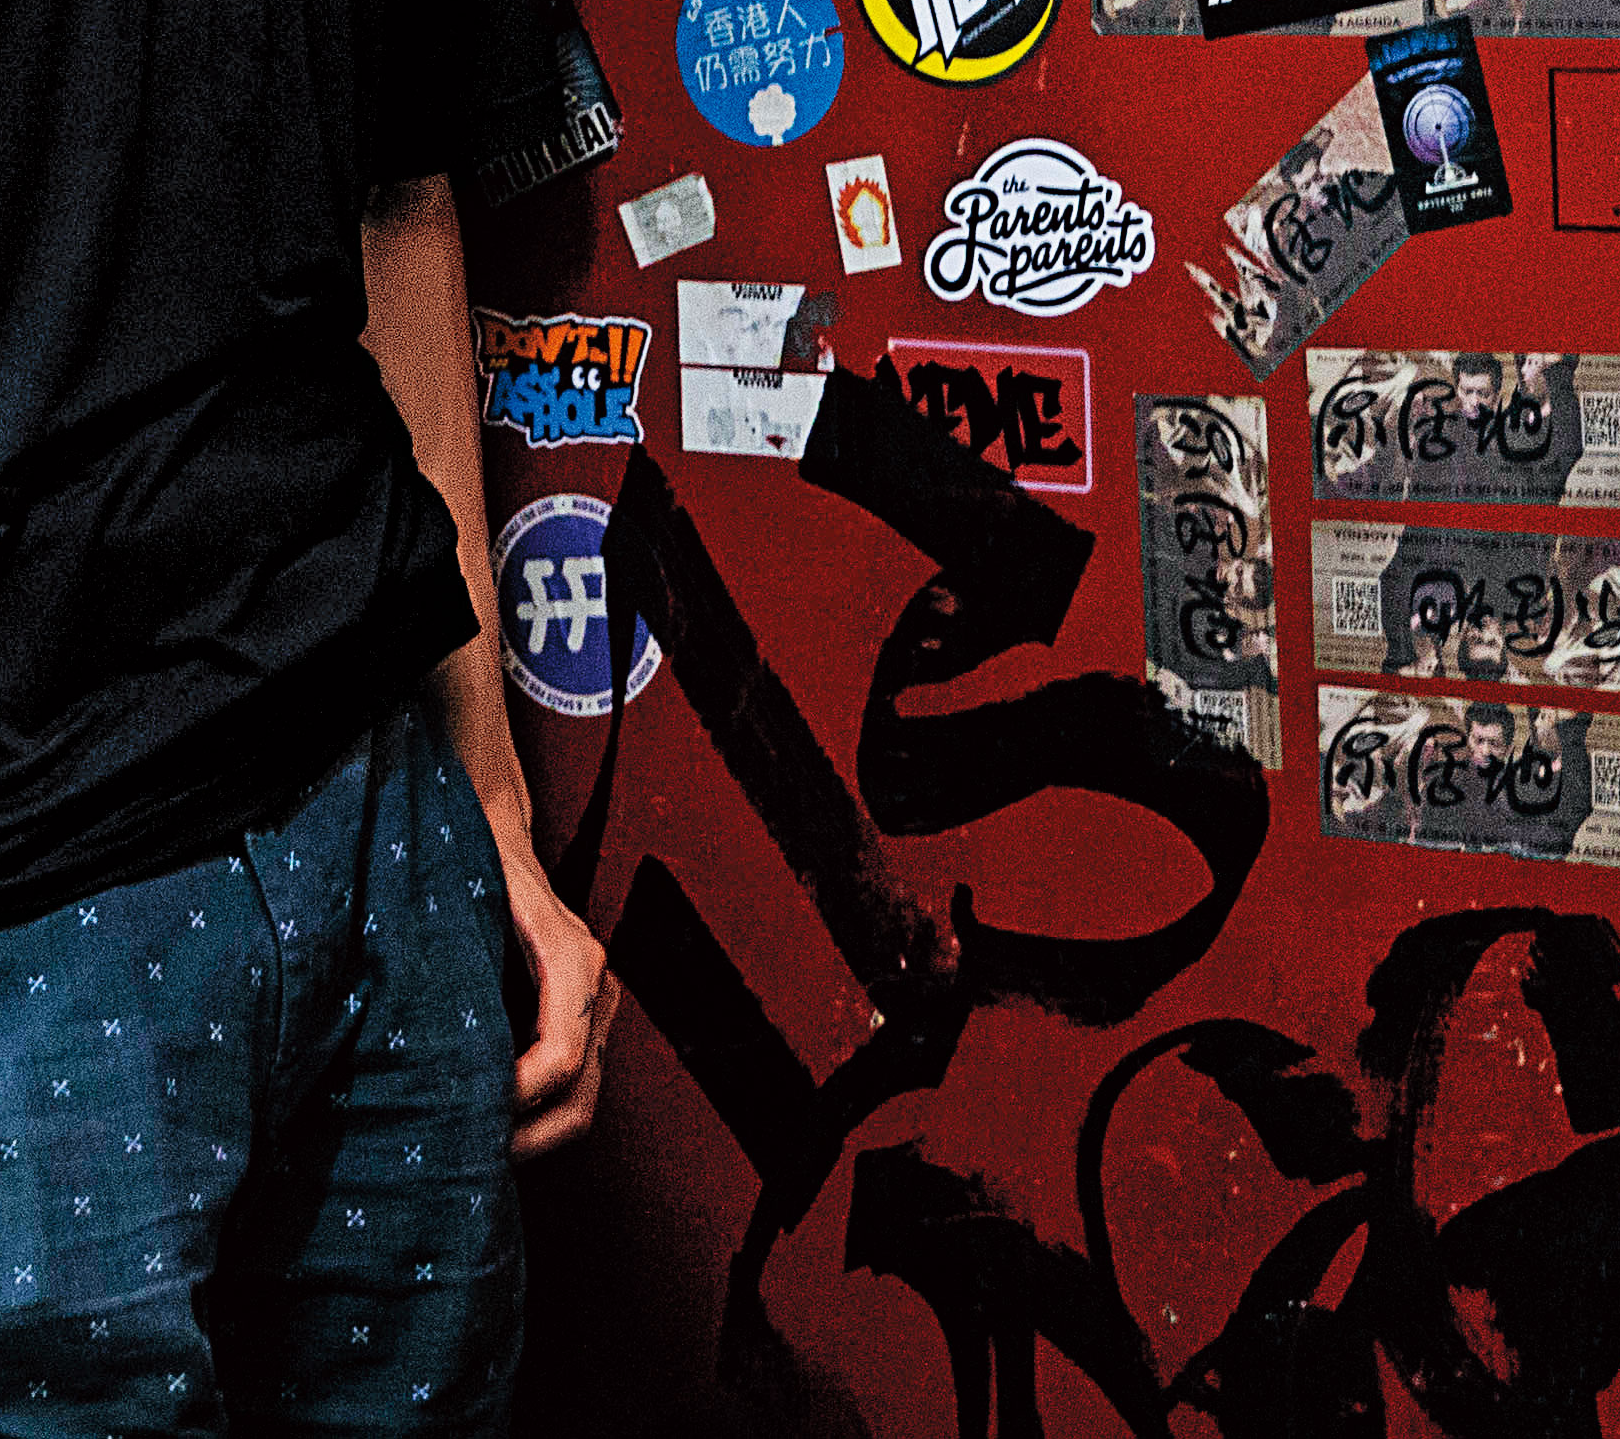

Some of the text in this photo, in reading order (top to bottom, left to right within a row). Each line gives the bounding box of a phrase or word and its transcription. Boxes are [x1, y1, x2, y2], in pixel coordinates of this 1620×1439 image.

[693, 30, 835, 94] 仍需努力
[1002, 176, 1032, 196] the
[1008, 216, 1149, 298] parents
